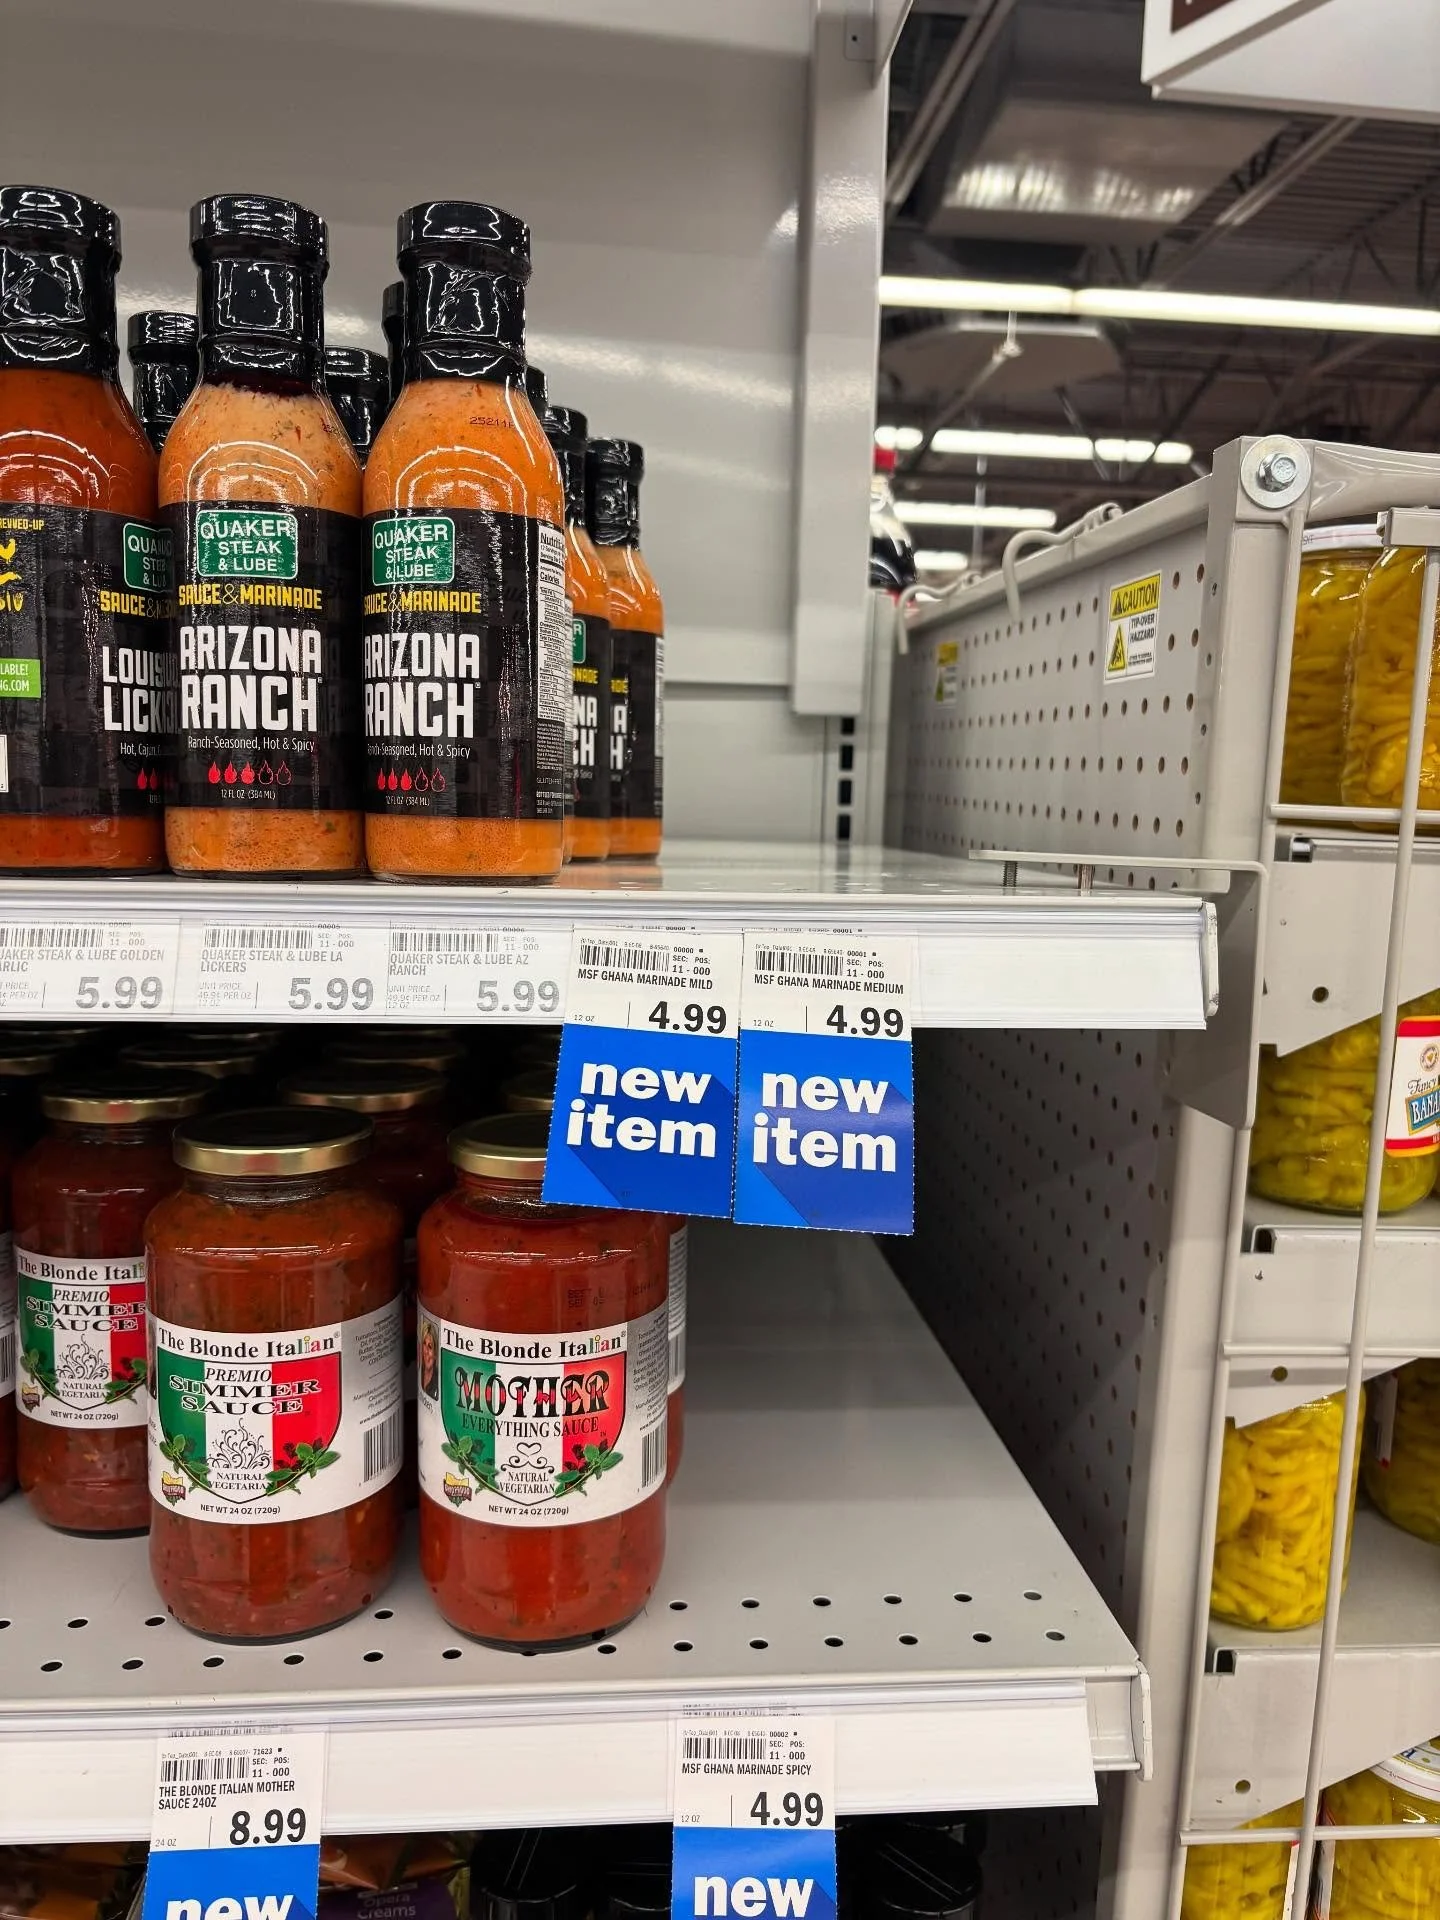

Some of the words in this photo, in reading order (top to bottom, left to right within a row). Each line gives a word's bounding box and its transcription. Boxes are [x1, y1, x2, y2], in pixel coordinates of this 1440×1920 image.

[200, 519, 291, 540] QUAKER
[374, 524, 449, 549] QUAKER
[218, 540, 282, 555] STEAK
[385, 547, 440, 562] STEAK
[218, 559, 229, 571] &
[234, 557, 278, 572] LUBE
[385, 566, 394, 579] &
[397, 564, 435, 578] LUBE
[100, 590, 146, 616] SAUCE
[1122, 582, 1158, 613] CAUTION
[180, 626, 322, 674] ARIZONA
[364, 632, 480, 680] ARIZONA
[181, 674, 318, 732] RANCH
[365, 682, 474, 738] RANCH
[120, 742, 137, 758] Hot,
[188, 736, 260, 751] Ranch-Seasoned,
[263, 737, 282, 750] Hot
[282, 738, 290, 750] &
[292, 737, 315, 753] Spicy
[419, 744, 435, 756] Hot
[437, 744, 444, 757] &
[446, 744, 471, 759] Spicy
[38, 949, 72, 961] STEAK
[76, 949, 85, 961] &
[88, 949, 118, 961] LUBE
[120, 950, 164, 961] GOLDEN
[201, 950, 246, 962] QUAKER
[249, 950, 284, 962] STEAK
[286, 951, 296, 962] &
[299, 951, 327, 962] LUBE
[330, 951, 343, 962] LA
[673, 946, 694, 954] 00000
[201, 961, 247, 973] LICKERS
[390, 953, 433, 966] QUAKER
[436, 954, 470, 965] STEAK
[473, 954, 482, 965] &
[484, 954, 513, 965] LUBE
[515, 954, 529, 965] AZ
[672, 955, 688, 963] SEC:
[694, 956, 711, 965] POS:
[846, 958, 862, 967] SEC:
[868, 960, 884, 968] POS:
[389, 965, 426, 976] RANCH
[672, 965, 683, 974] 11
[693, 966, 711, 976] 000
[846, 969, 858, 977] 11
[867, 970, 885, 979] 000
[578, 968, 600, 980] MSF
[601, 970, 634, 983] GHANA
[636, 973, 687, 988] MARINADE
[689, 978, 713, 990] MILD
[754, 974, 775, 985] MSF
[777, 975, 809, 988] GHANA
[812, 978, 861, 992] MARINADE
[863, 982, 904, 995] MEDIUM
[75, 976, 163, 1009] 5.99
[288, 977, 374, 1011] 5.99
[476, 980, 560, 1012] 5.99
[648, 1001, 727, 1034] 4.99
[753, 1019, 762, 1027] 12
[826, 1004, 904, 1038] 4.99
[580, 1062, 712, 1104] new
[762, 1072, 889, 1115] new
[566, 1098, 717, 1158] item
[753, 1112, 896, 1172] item
[19, 1255, 38, 1275] The
[41, 1262, 99, 1281] Blonde
[54, 1288, 110, 1302] PREMIO
[35, 1314, 139, 1332] SAUCE
[159, 1327, 185, 1351] The
[190, 1336, 259, 1358] Blonde
[266, 1335, 335, 1357] Italian
[443, 1327, 474, 1352] The
[480, 1338, 552, 1359] Blonde
[558, 1335, 622, 1358] Italian
[205, 1367, 272, 1383] PREMIO
[63, 1381, 105, 1390] NATURAL
[169, 1374, 322, 1399] SIMMER
[454, 1366, 610, 1419] MOTHER
[60, 1390, 108, 1399] EGETARIA
[181, 1395, 304, 1415] SAUCE
[51, 1410, 62, 1418] NET
[62, 1411, 73, 1419] WT
[74, 1412, 83, 1420] 24
[84, 1412, 94, 1420] OZ
[95, 1411, 119, 1421] (720g)
[462, 1416, 550, 1439] EVERYTHING
[553, 1416, 599, 1437] SAUCE
[216, 1472, 266, 1481] NATURAL
[507, 1471, 549, 1483] NATURAL
[208, 1481, 274, 1491] VEGETARIAN
[499, 1482, 556, 1495] VEGETARIAN
[200, 1503, 215, 1513] NET
[215, 1505, 228, 1514] WT
[229, 1506, 239, 1515] 24
[241, 1506, 253, 1515] OZ
[254, 1505, 281, 1516] (720g)
[488, 1504, 503, 1514] NET
[504, 1506, 517, 1515] WT
[519, 1507, 529, 1515] 24
[530, 1506, 543, 1516] OZ
[543, 1505, 569, 1516] (720g)
[769, 1740, 784, 1748] SEC:
[252, 1748, 273, 1756] 71623
[769, 1751, 779, 1760] 11
[789, 1751, 806, 1760] 000
[252, 1757, 268, 1765] SEC:
[274, 1756, 290, 1764] POS:
[252, 1769, 263, 1777] 11
[273, 1768, 290, 1777] 000
[682, 1763, 702, 1774] MSF
[704, 1763, 734, 1775] GHANA
[737, 1764, 783, 1775] MARINADE
[786, 1764, 812, 1776] SPICY
[159, 1785, 177, 1797] THE
[180, 1784, 216, 1796] BLONDE
[219, 1782, 254, 1795] ITALIAN
[256, 1780, 295, 1793] MOTHER
[159, 1797, 190, 1809] SAUCE
[192, 1796, 217, 1808] 24OZ
[750, 1791, 824, 1827] 4.99
[229, 1807, 306, 1846] 8.99
[681, 1815, 690, 1823] 12
[691, 1815, 701, 1823] OZ
[155, 1839, 165, 1848] 24
[167, 1838, 177, 1847] OZ
[364, 1893, 410, 1907] Opera
[694, 1876, 814, 1918] new
[166, 1894, 294, 1920] new
[357, 1905, 416, 1919] Creams
